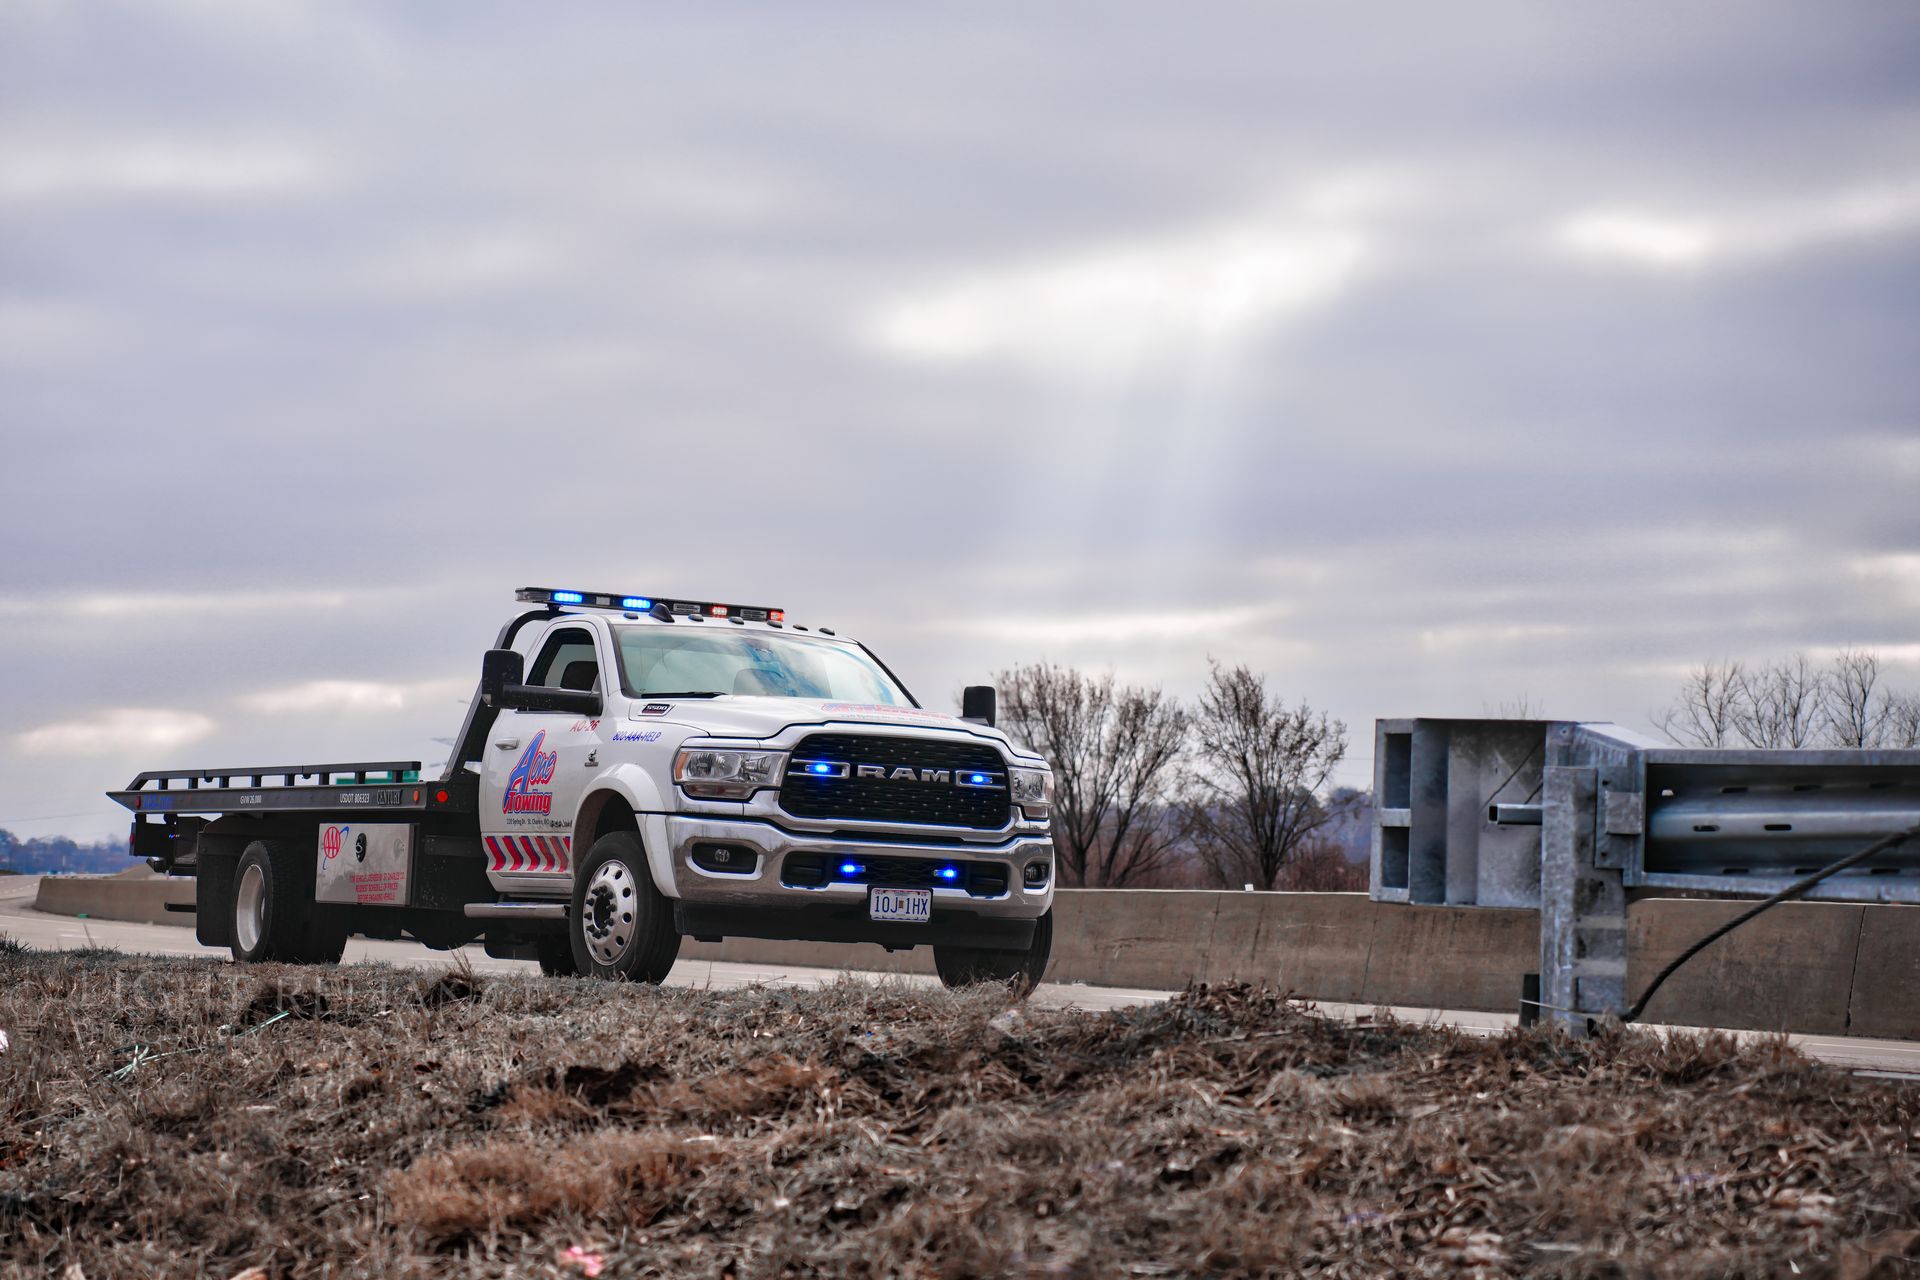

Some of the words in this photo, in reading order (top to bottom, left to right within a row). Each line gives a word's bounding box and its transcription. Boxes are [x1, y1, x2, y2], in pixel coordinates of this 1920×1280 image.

[569, 719, 600, 732] AO-26
[856, 764, 950, 783] RAM
[339, 793, 354, 803] USDOT
[508, 789, 553, 815] Towing
[324, 826, 341, 859] AAA
[875, 896, 898, 913] 10J
[905, 897, 928, 915] 1HX
